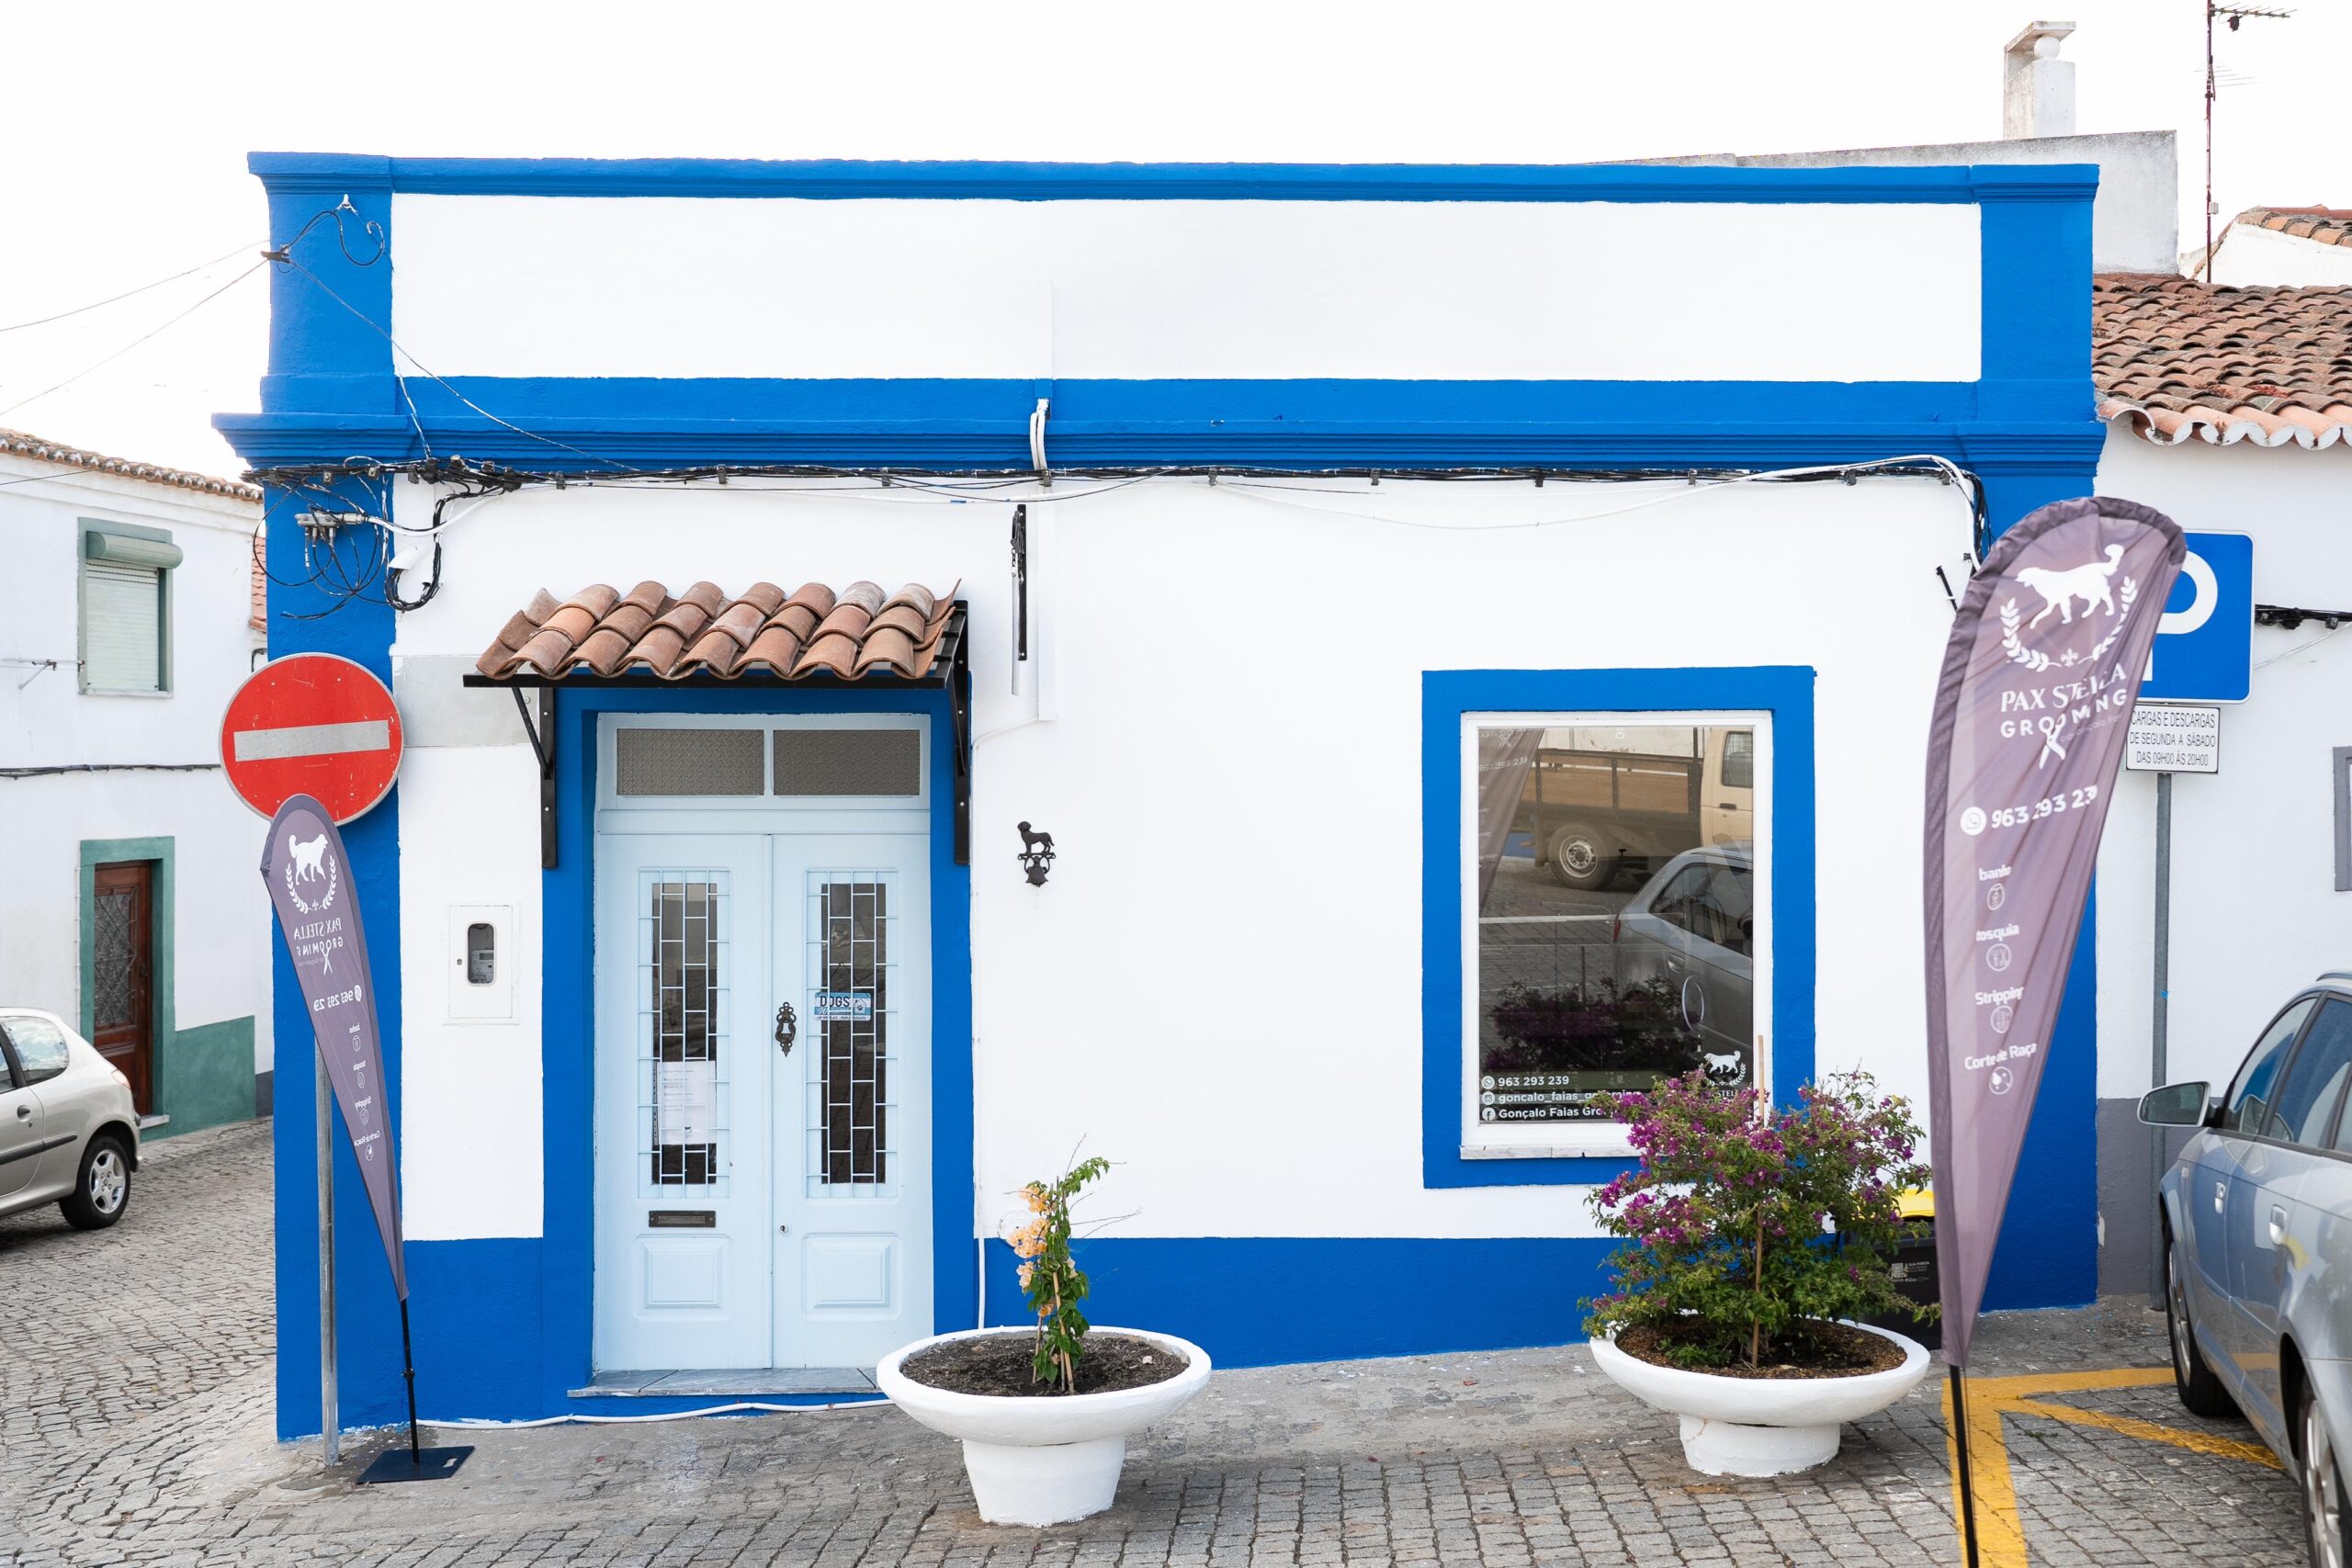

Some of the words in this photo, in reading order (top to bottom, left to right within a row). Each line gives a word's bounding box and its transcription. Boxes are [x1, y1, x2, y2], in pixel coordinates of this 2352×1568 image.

[2001, 688, 2046, 712] PAX
[2132, 711, 2161, 726] CARGAS
[2164, 712, 2168, 726] E
[2170, 712, 2215, 728] DESCARGAS
[2130, 732, 2140, 744] DE
[2142, 732, 2176, 745] SEGUNDA
[2178, 734, 2184, 745] A
[2187, 732, 2215, 747] SÁBADO
[2136, 751, 2151, 763] DAS
[2153, 752, 2174, 764] 09H00
[2188, 753, 2209, 765] 20H00
[1991, 806, 2029, 829] 963
[2032, 793, 2066, 819] 293
[820, 996, 850, 1007] DOGS
[1498, 1077, 1521, 1088] 963
[1523, 1077, 1544, 1087] 293
[1547, 1076, 1570, 1086] 239
[1498, 1108, 1546, 1120] Gonçalo
[1549, 1107, 1579, 1118] Faias
